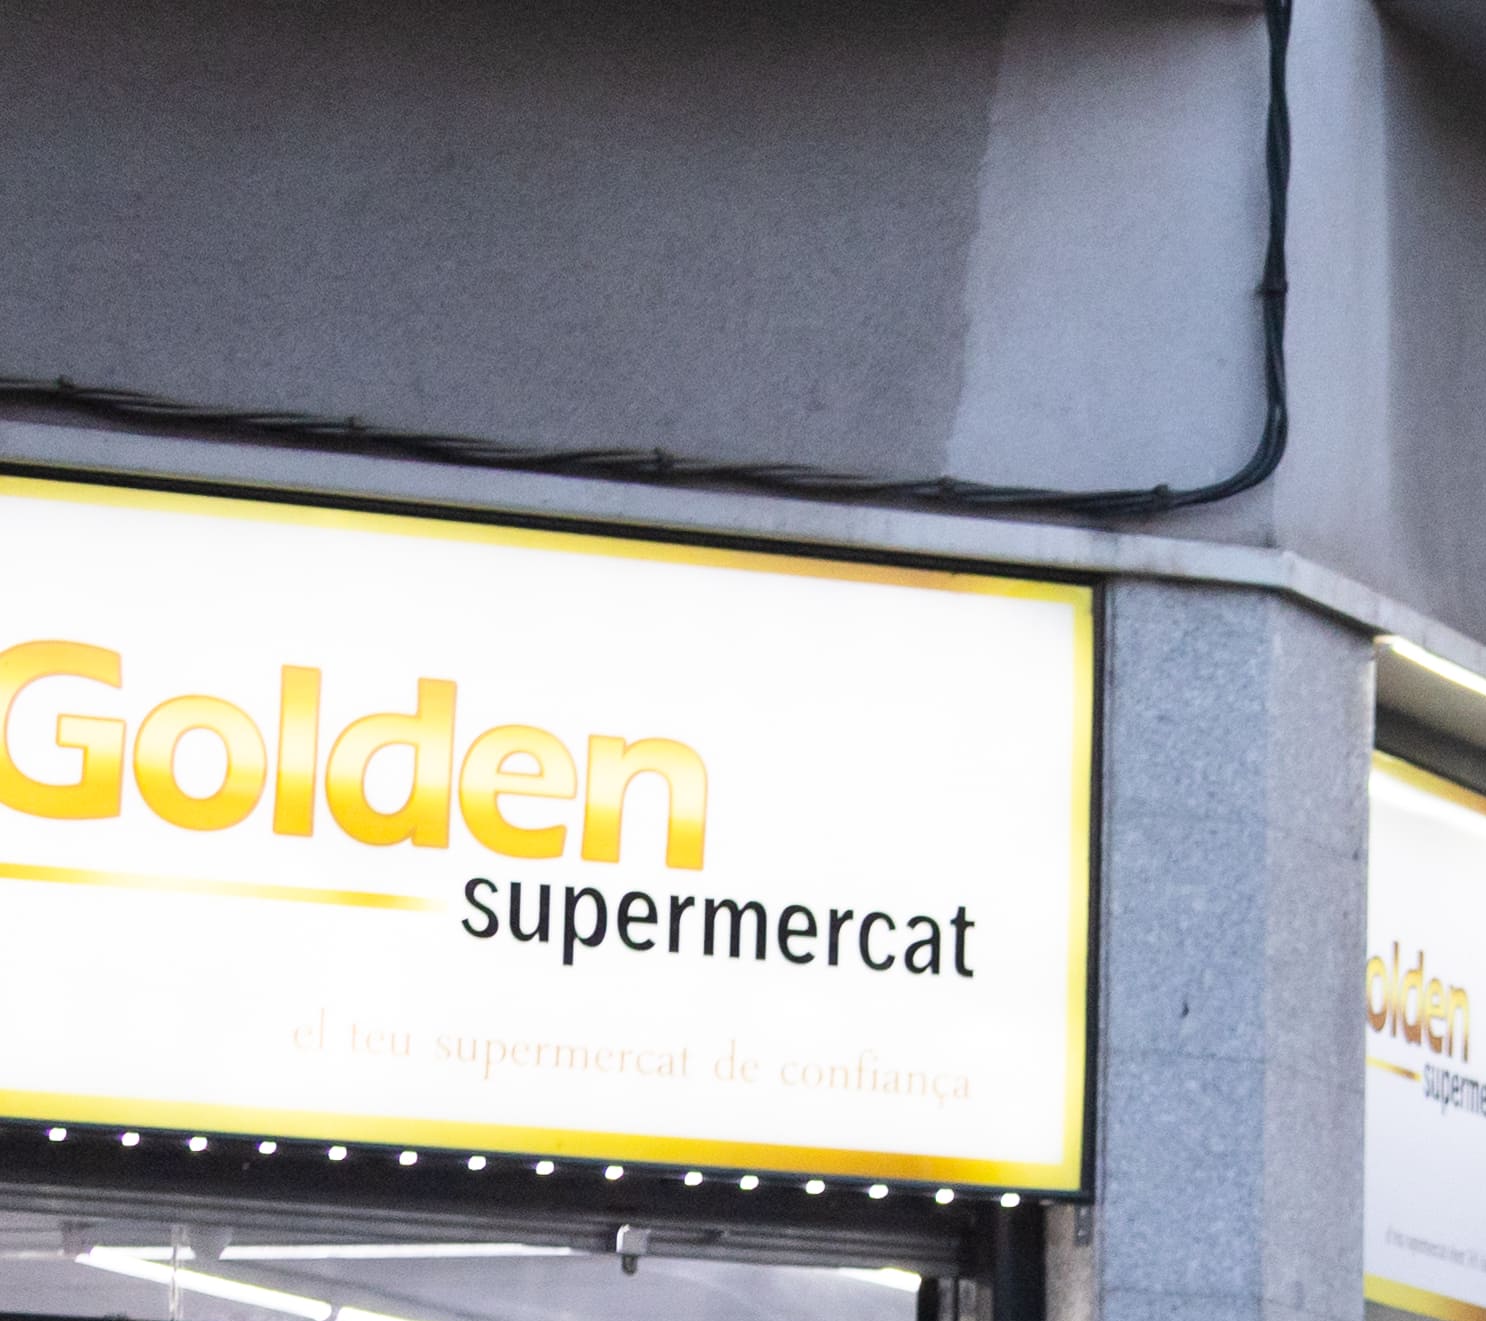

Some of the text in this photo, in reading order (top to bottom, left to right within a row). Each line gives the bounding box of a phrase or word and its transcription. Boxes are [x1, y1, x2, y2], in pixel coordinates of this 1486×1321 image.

[0, 639, 708, 870] Golden
[461, 876, 975, 978] supermercat
[292, 1008, 971, 1100] el teu supermercat de confiança
